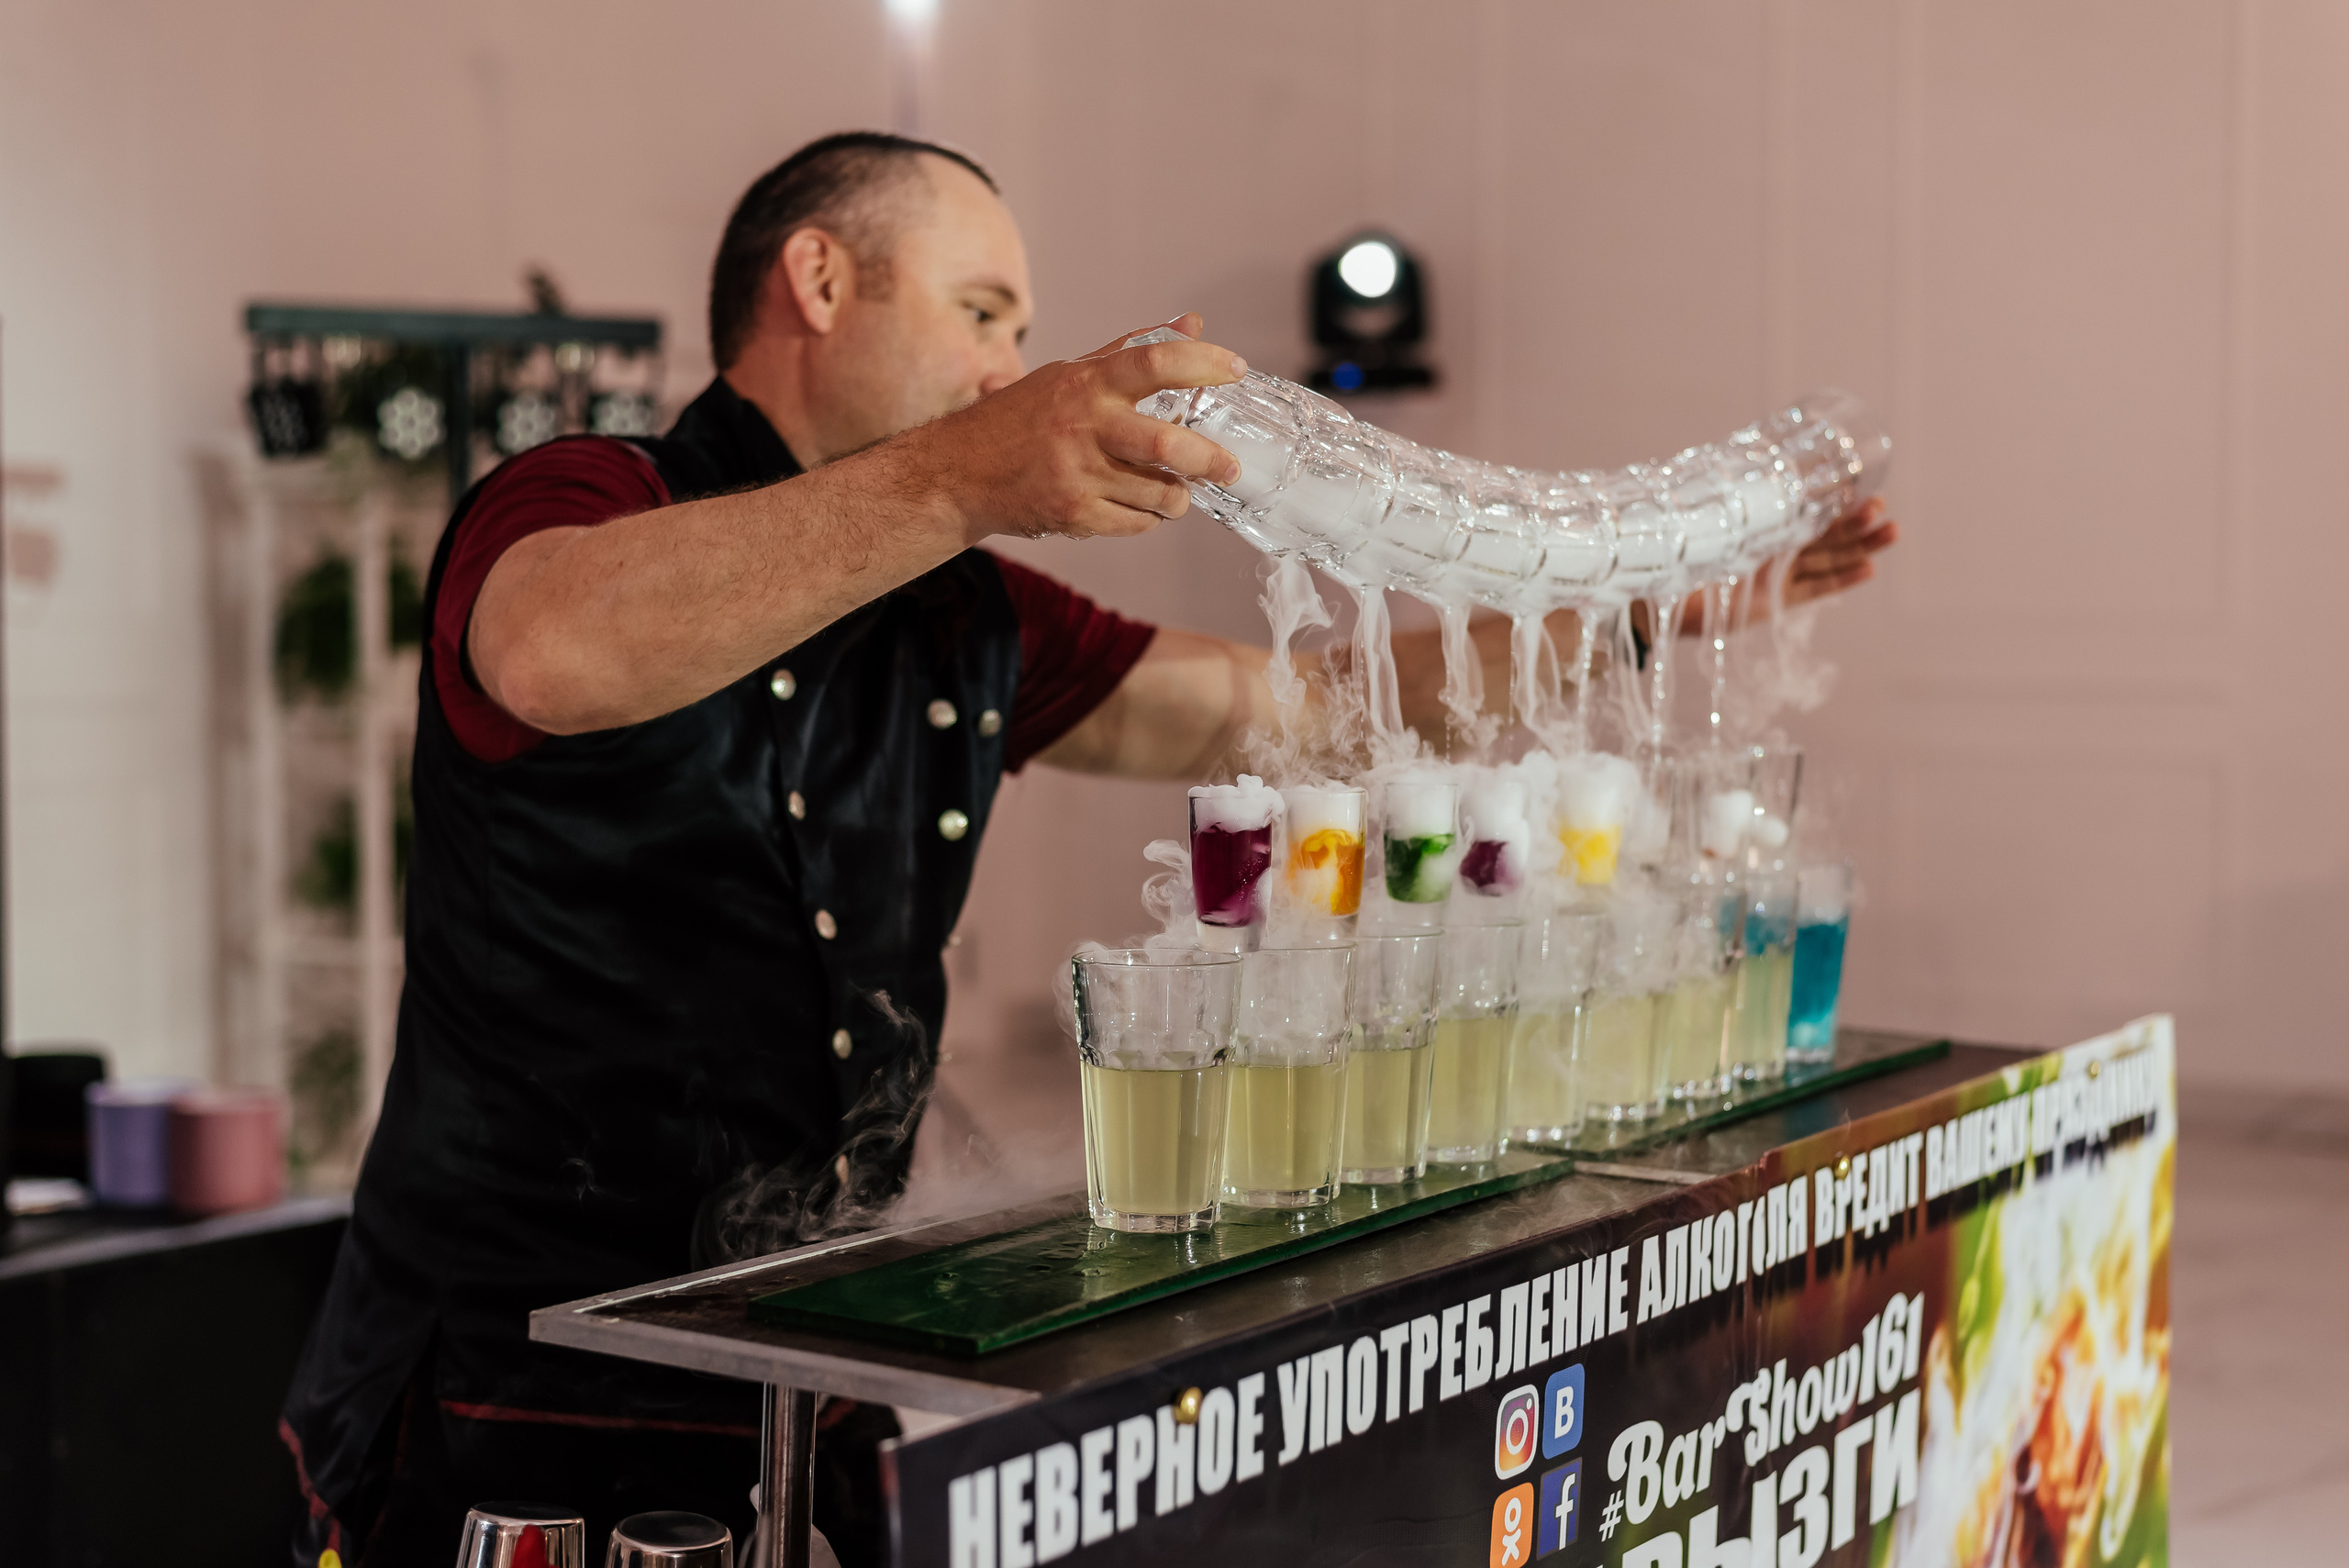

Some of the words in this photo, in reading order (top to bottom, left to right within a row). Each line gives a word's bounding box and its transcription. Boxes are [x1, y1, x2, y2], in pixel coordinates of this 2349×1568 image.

[948, 1371, 1265, 1568] НЕВЕРНОЕ
[1276, 1245, 1630, 1467] УПОТРЕБЛЕНИЕ
[1636, 1175, 1809, 1325] АЛКОГОЛЯ
[1814, 1130, 1924, 1249] ВРЕДИТ
